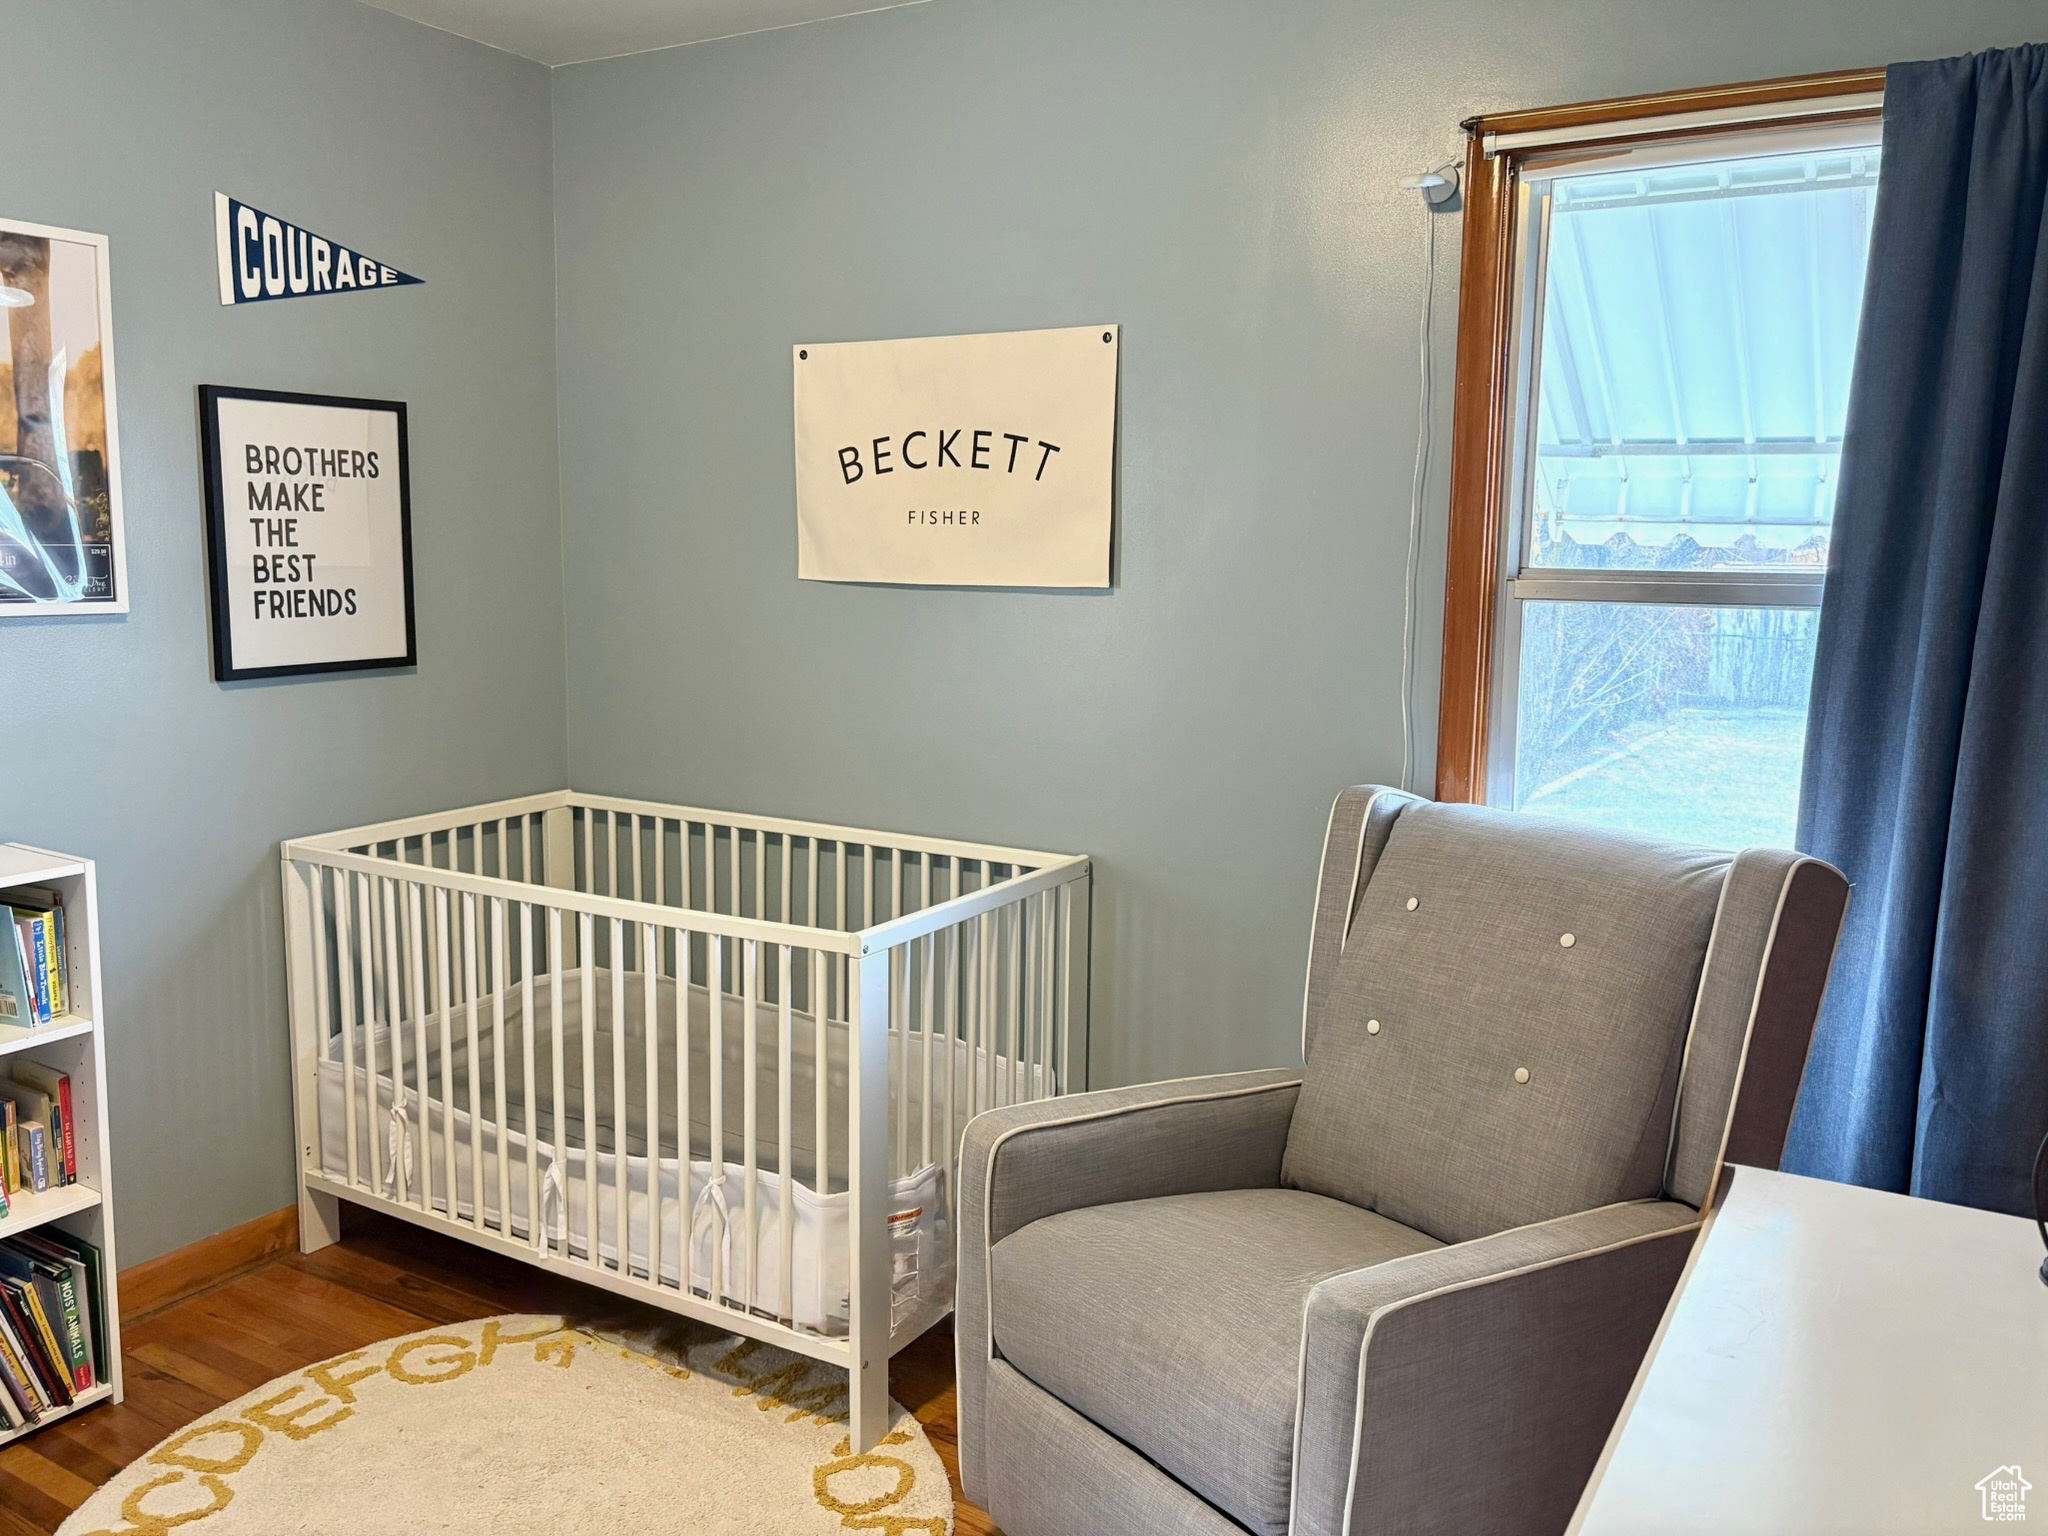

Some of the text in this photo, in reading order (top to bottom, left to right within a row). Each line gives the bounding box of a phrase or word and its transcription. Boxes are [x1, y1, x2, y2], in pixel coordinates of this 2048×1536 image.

[237, 205, 398, 299] COURAGE
[245, 444, 380, 479] BROTHERS
[838, 429, 1061, 485] BECKETT
[247, 481, 326, 512] MAKE
[250, 518, 299, 547] THE
[908, 510, 981, 525] FISHER
[253, 554, 317, 583] BEST
[254, 588, 357, 619] FRIENDS
[61, 1281, 83, 1359] NOISY ANIMALS
